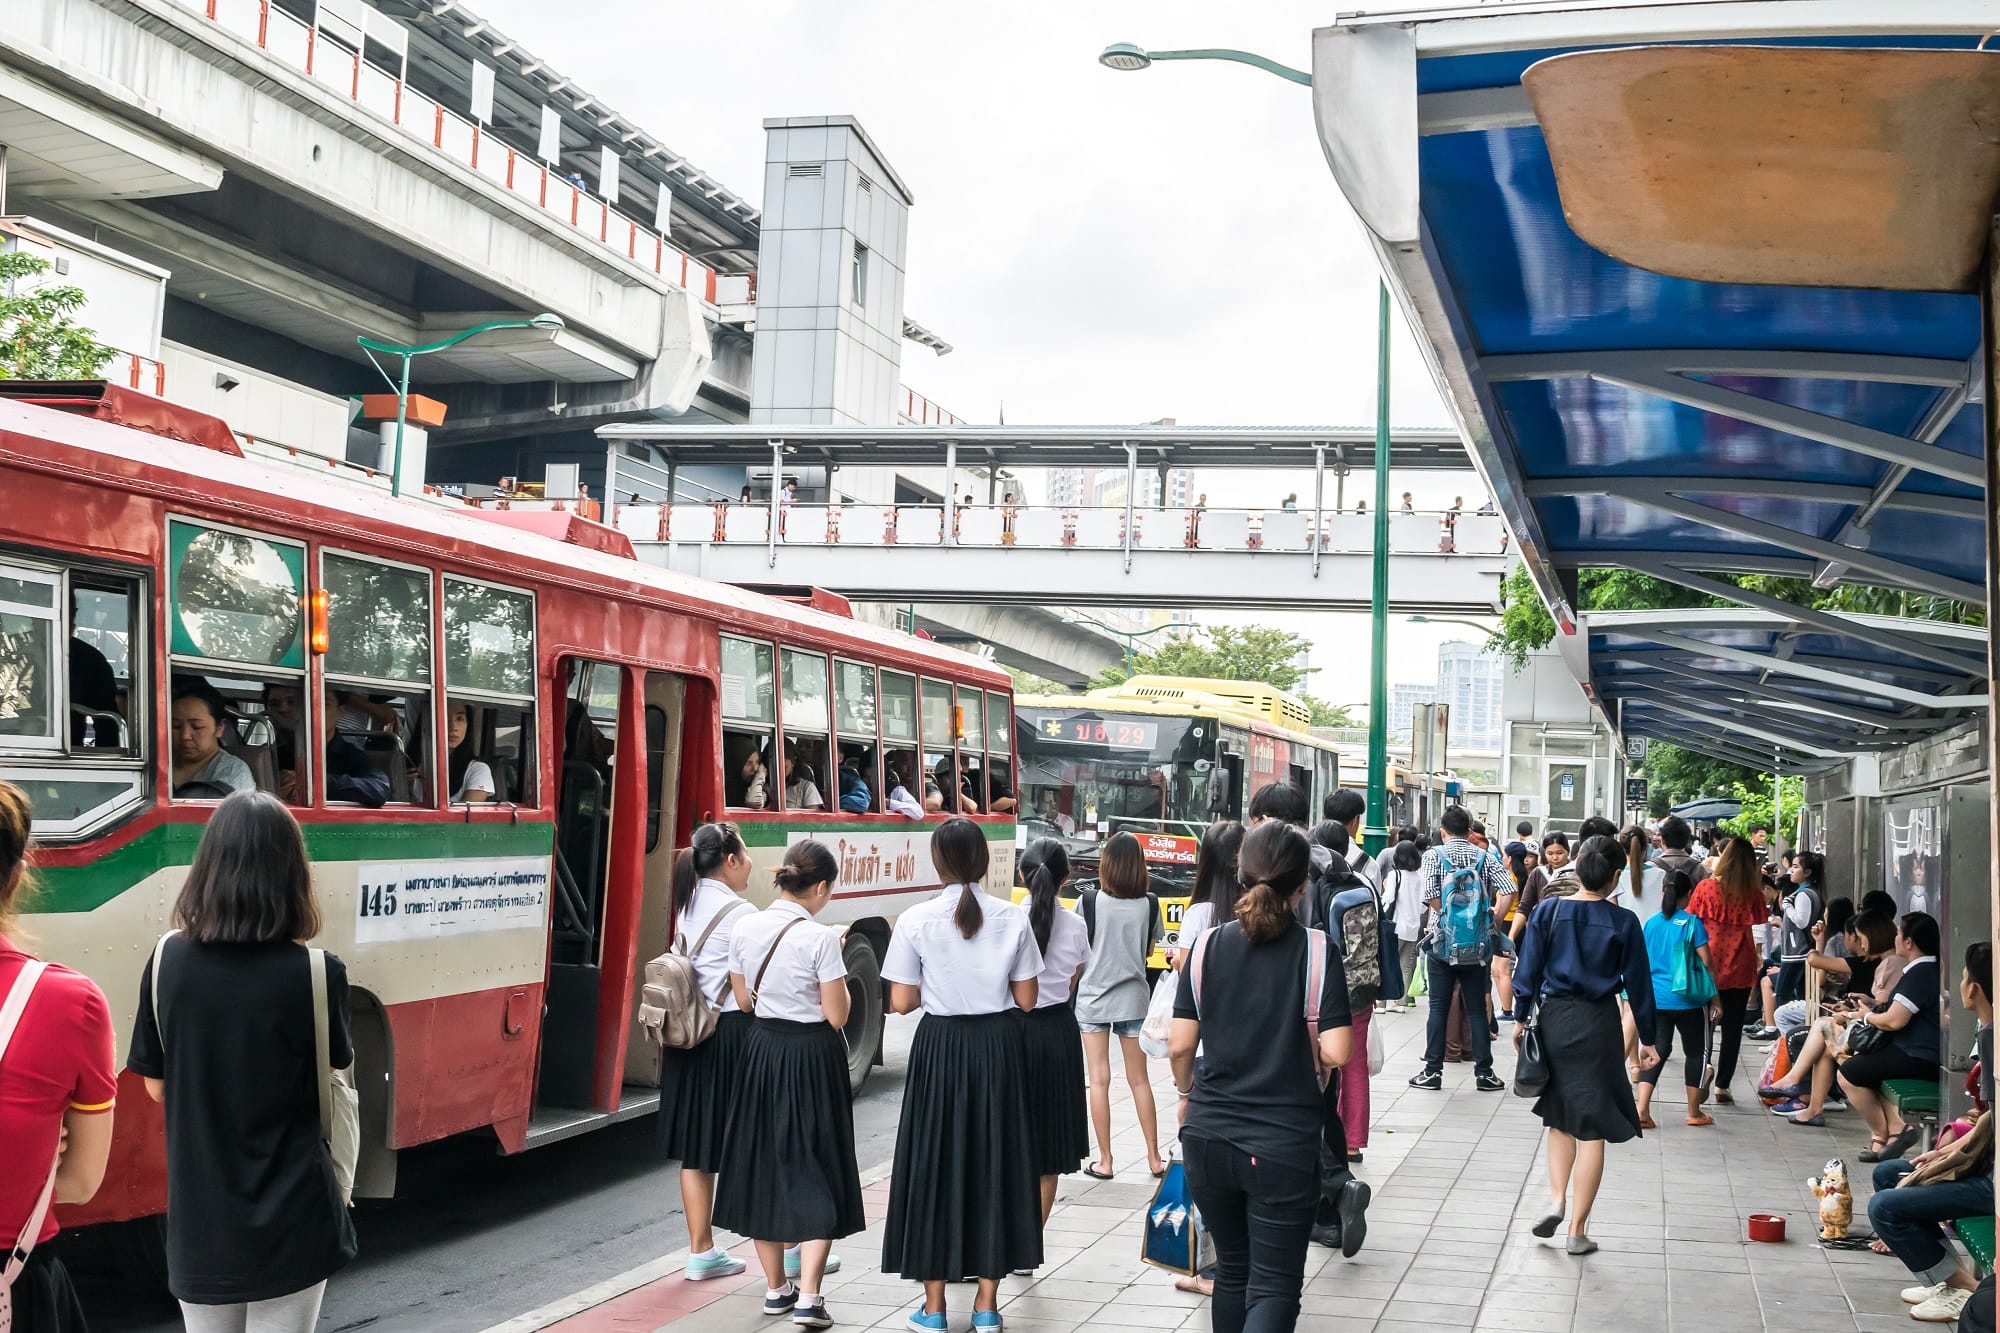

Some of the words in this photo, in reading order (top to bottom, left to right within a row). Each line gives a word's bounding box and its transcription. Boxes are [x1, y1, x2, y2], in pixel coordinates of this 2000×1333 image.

[1148, 835, 1177, 849] รังสิต
[839, 838, 881, 887] ให้เหล้า
[895, 838, 915, 883] แช่ง
[360, 882, 398, 917] 145
[537, 891, 543, 905] 2
